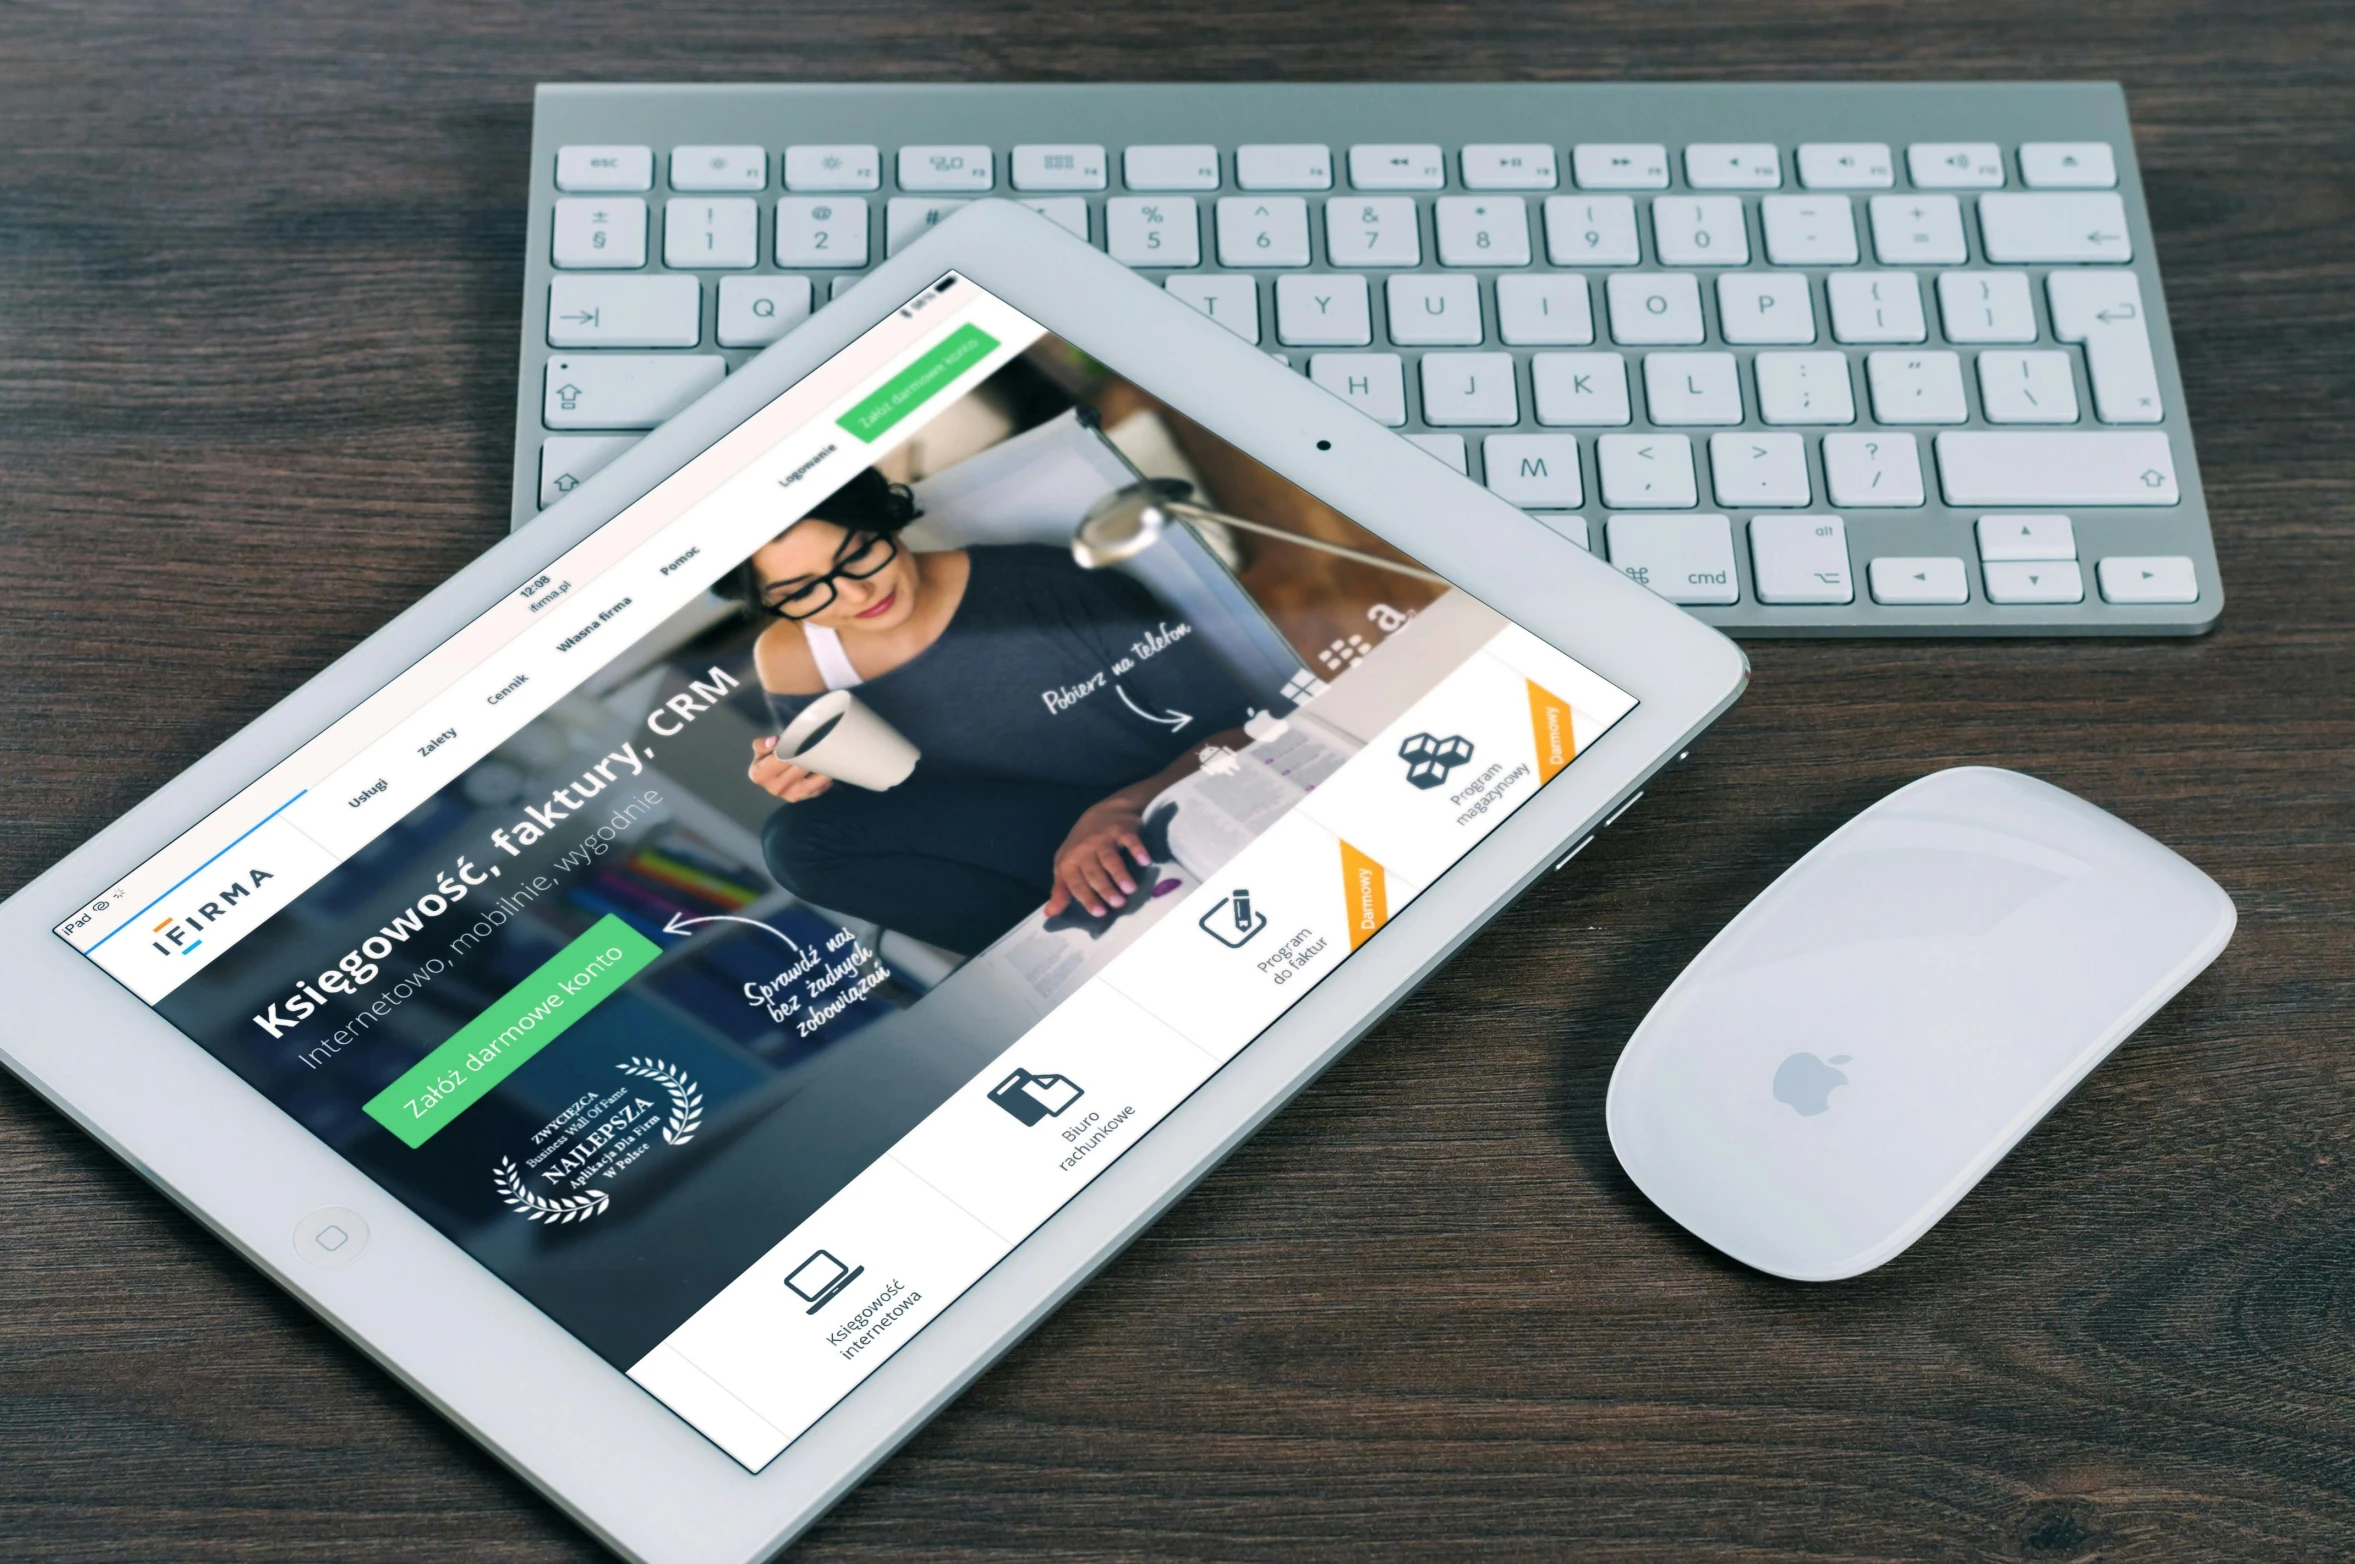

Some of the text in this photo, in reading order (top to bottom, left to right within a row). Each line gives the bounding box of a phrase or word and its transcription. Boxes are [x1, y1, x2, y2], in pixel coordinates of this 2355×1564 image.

[589, 156, 619, 169] esc
[746, 168, 759, 177] F1
[856, 168, 872, 178] F2
[971, 168, 986, 178] F3
[1084, 168, 1098, 176] F4
[1423, 166, 1438, 176] F7
[811, 206, 833, 221] @
[1141, 206, 1165, 224] %
[1361, 206, 1379, 224] &
[814, 231, 829, 250] 2
[1147, 231, 1161, 250] 5
[1256, 231, 1272, 249] 6
[1365, 231, 1380, 249] 7
[1475, 231, 1491, 249] 8
[1584, 231, 1600, 248] 9
[752, 298, 775, 318] Q
[1204, 296, 1218, 316] T
[1314, 296, 1331, 315] Y
[1424, 296, 1445, 316] U
[1645, 295, 1668, 315] O
[1758, 295, 1775, 314] P
[892, 363, 944, 405] darmowe
[1348, 376, 1369, 395] H
[1464, 375, 1476, 396] J
[1573, 375, 1593, 394] K
[1686, 375, 1703, 395] L
[1637, 446, 1654, 460] <
[1752, 445, 1768, 459] >
[1865, 442, 1879, 461] ?
[778, 443, 837, 487] Logowanie
[1520, 457, 1548, 478] M
[1871, 470, 1882, 489] /
[1815, 526, 1834, 537] alt
[660, 545, 701, 577] Pomoc
[520, 574, 552, 599] 12:08
[1687, 569, 1728, 586] cmd
[528, 579, 572, 614] ifirma.pl
[556, 595, 633, 654] Własna firma
[1041, 620, 1192, 715] Pobierz na telefon
[487, 673, 530, 706] Cennik
[417, 726, 458, 759] Zalety
[1549, 706, 1564, 766] Darmowy
[348, 777, 389, 811] Usługi
[1450, 760, 1504, 807] Program
[1456, 762, 1531, 828] magazynowy
[252, 665, 741, 1040] Księgowość, faktury, CRM
[1360, 868, 1376, 931] Darmowy
[152, 868, 275, 957] IFIRMA
[61, 913, 92, 937] iPad
[298, 786, 665, 1071] Internetowo, mobilnie, wygodnie
[1256, 926, 1313, 975] Program
[1273, 936, 1329, 987] do faktur
[743, 927, 856, 1007] Sprawdź nas
[767, 995, 801, 1023] bez
[796, 962, 891, 1038] zobowiązań
[403, 946, 624, 1120] Załóż darmowe konto
[525, 1087, 629, 1169] Business Wall Of Fame
[1058, 1103, 1136, 1172] rachunkowe
[1061, 1110, 1100, 1144] Biuro
[541, 1097, 656, 1186] NAJLEPSZA
[570, 1115, 662, 1190] Aplikacja Dla Firm
[602, 1142, 650, 1179] W Polsce
[825, 1278, 907, 1347] Księgowość
[838, 1289, 923, 1362] internetowa
